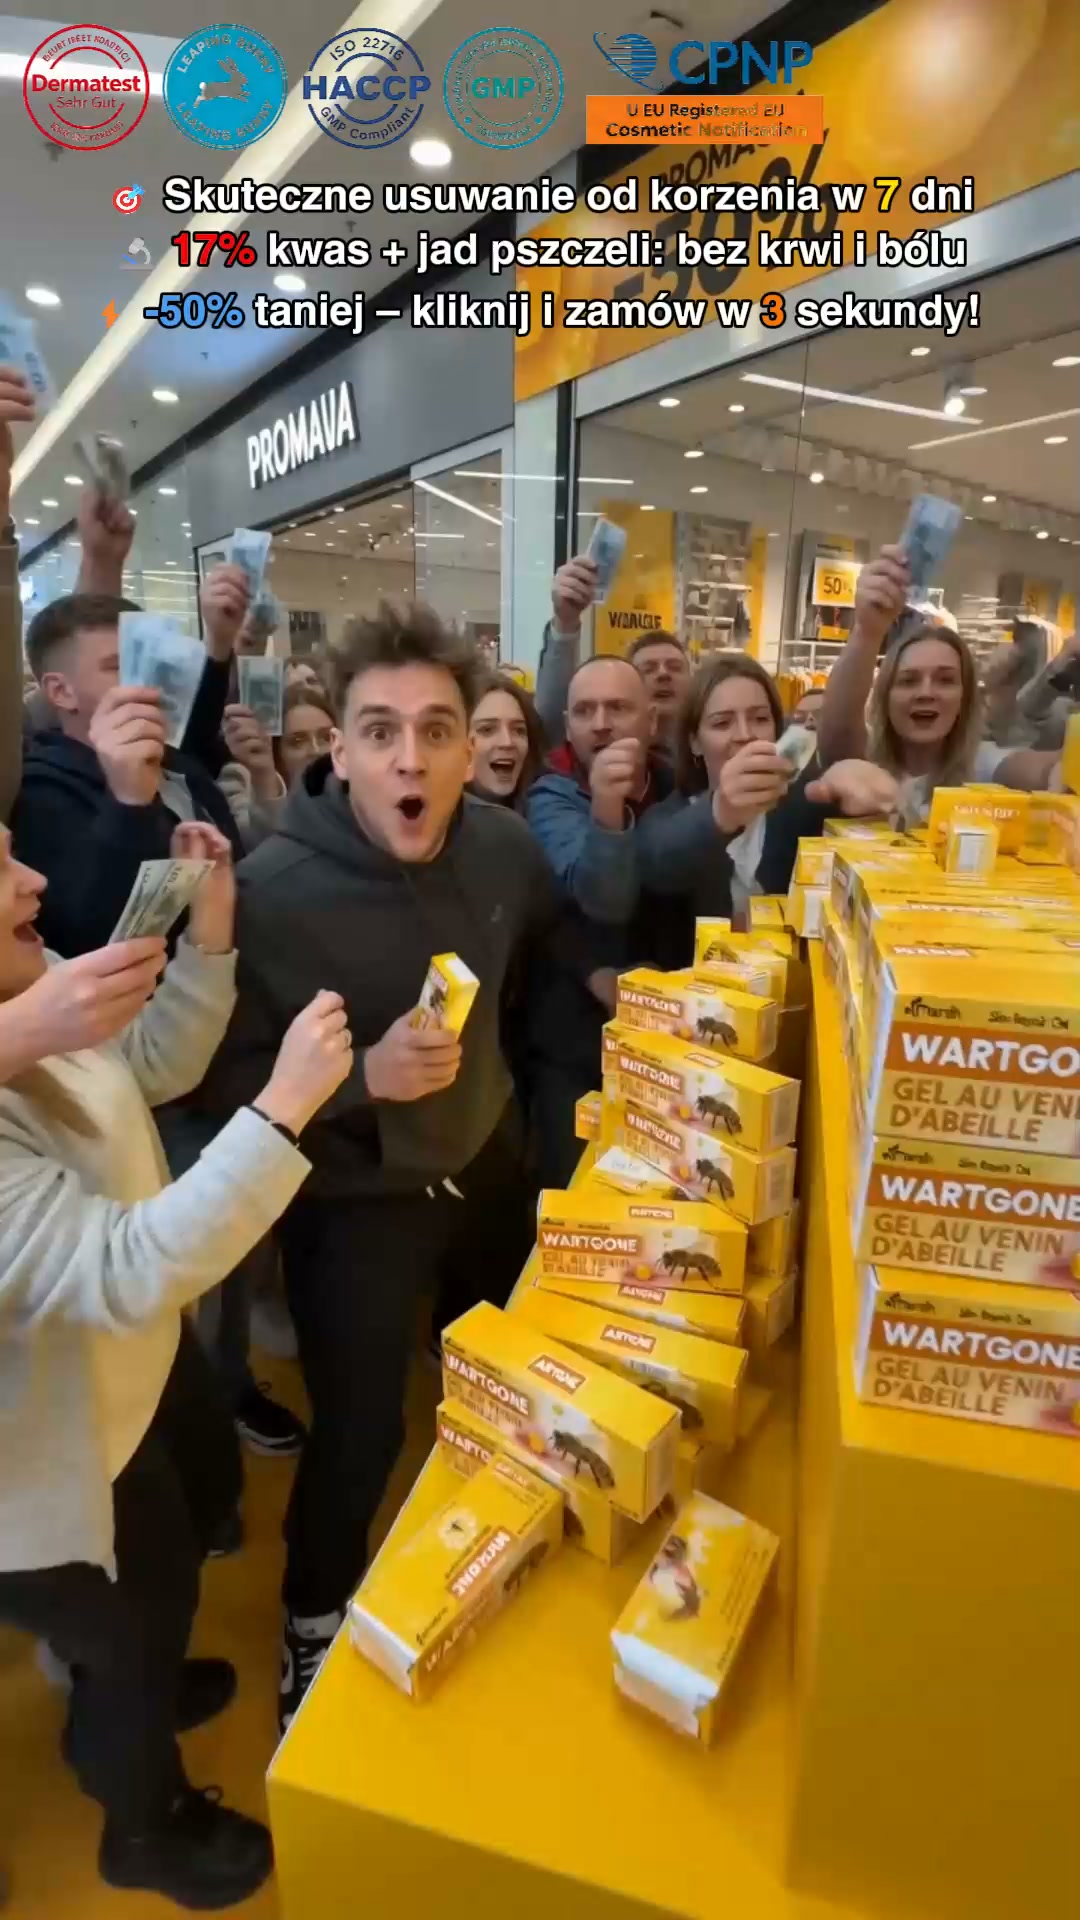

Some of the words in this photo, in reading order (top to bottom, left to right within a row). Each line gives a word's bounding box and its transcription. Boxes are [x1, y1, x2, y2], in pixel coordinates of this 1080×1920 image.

[246, 379, 356, 489] PROMAVA
[901, 1031, 1080, 1078] WARTGO
[893, 1078, 949, 1105] GEL
[954, 1083, 1002, 1110] AU
[889, 1103, 1044, 1143] D'ABEILLE
[870, 1235, 1009, 1273] D'ABEILLE
[873, 1212, 924, 1239] GEL
[929, 1218, 971, 1244] AU
[978, 1224, 1065, 1256] VENIN
[873, 1378, 1009, 1417] D'ABEILLE
[875, 1357, 925, 1382] GEL
[930, 1364, 972, 1389] AU
[978, 1370, 1066, 1401] VENIN
